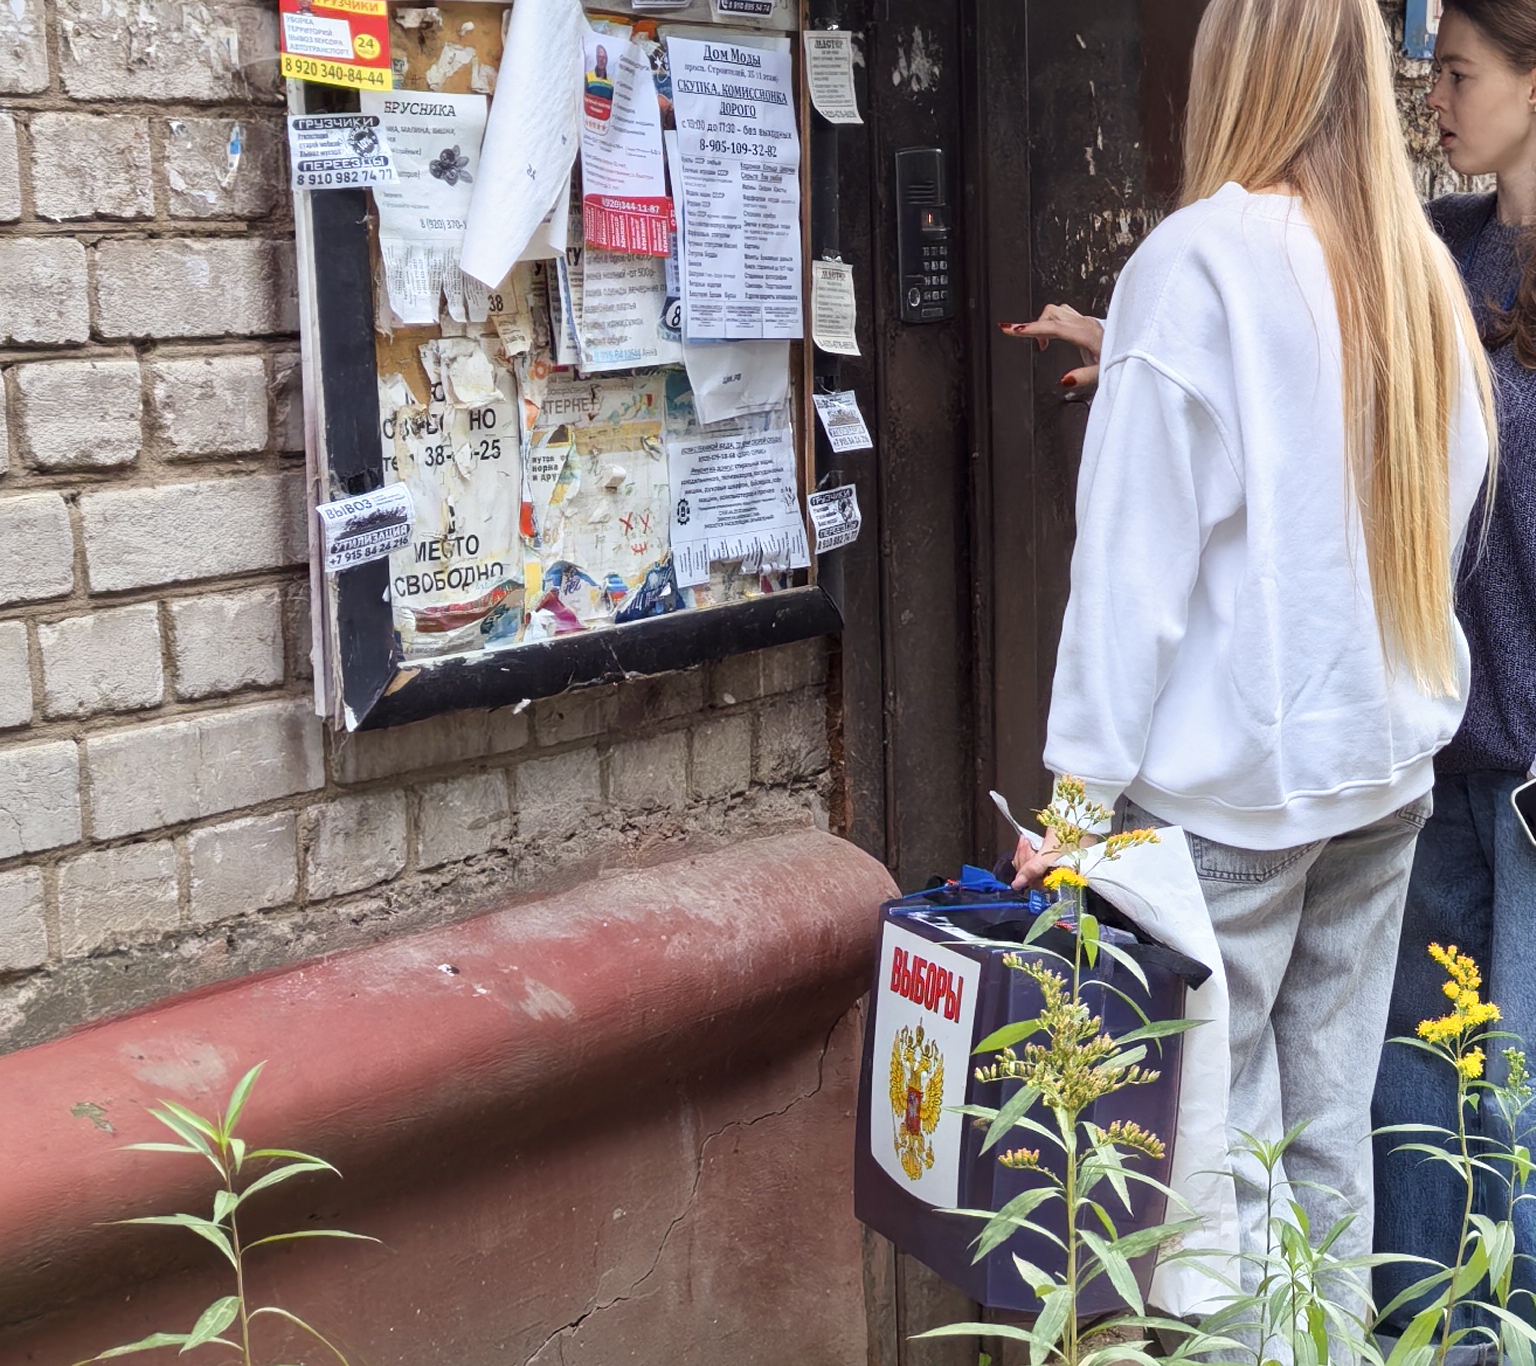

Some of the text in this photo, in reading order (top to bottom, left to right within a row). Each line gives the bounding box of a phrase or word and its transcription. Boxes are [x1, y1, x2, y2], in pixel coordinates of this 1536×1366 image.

[357, 37, 375, 49] 24
[703, 44, 762, 67] Дом Моды
[285, 58, 385, 86] 8 920 340-84-44
[720, 101, 757, 119] ДОРОГО
[299, 116, 374, 129] ГРУЗЧИКИ
[706, 123, 719, 132] до
[699, 138, 778, 158] 8-905-109-32-82
[303, 156, 385, 171] ПЕРЕЕЗДЫ
[297, 175, 305, 186] 8
[308, 173, 333, 186] 910
[362, 170, 377, 182] 74
[378, 168, 392, 180] 77
[324, 498, 373, 520] ВЫВОЗ
[330, 554, 342, 566] +7
[344, 549, 362, 563] 915
[889, 945, 965, 1024] ВЫБОРЫ
